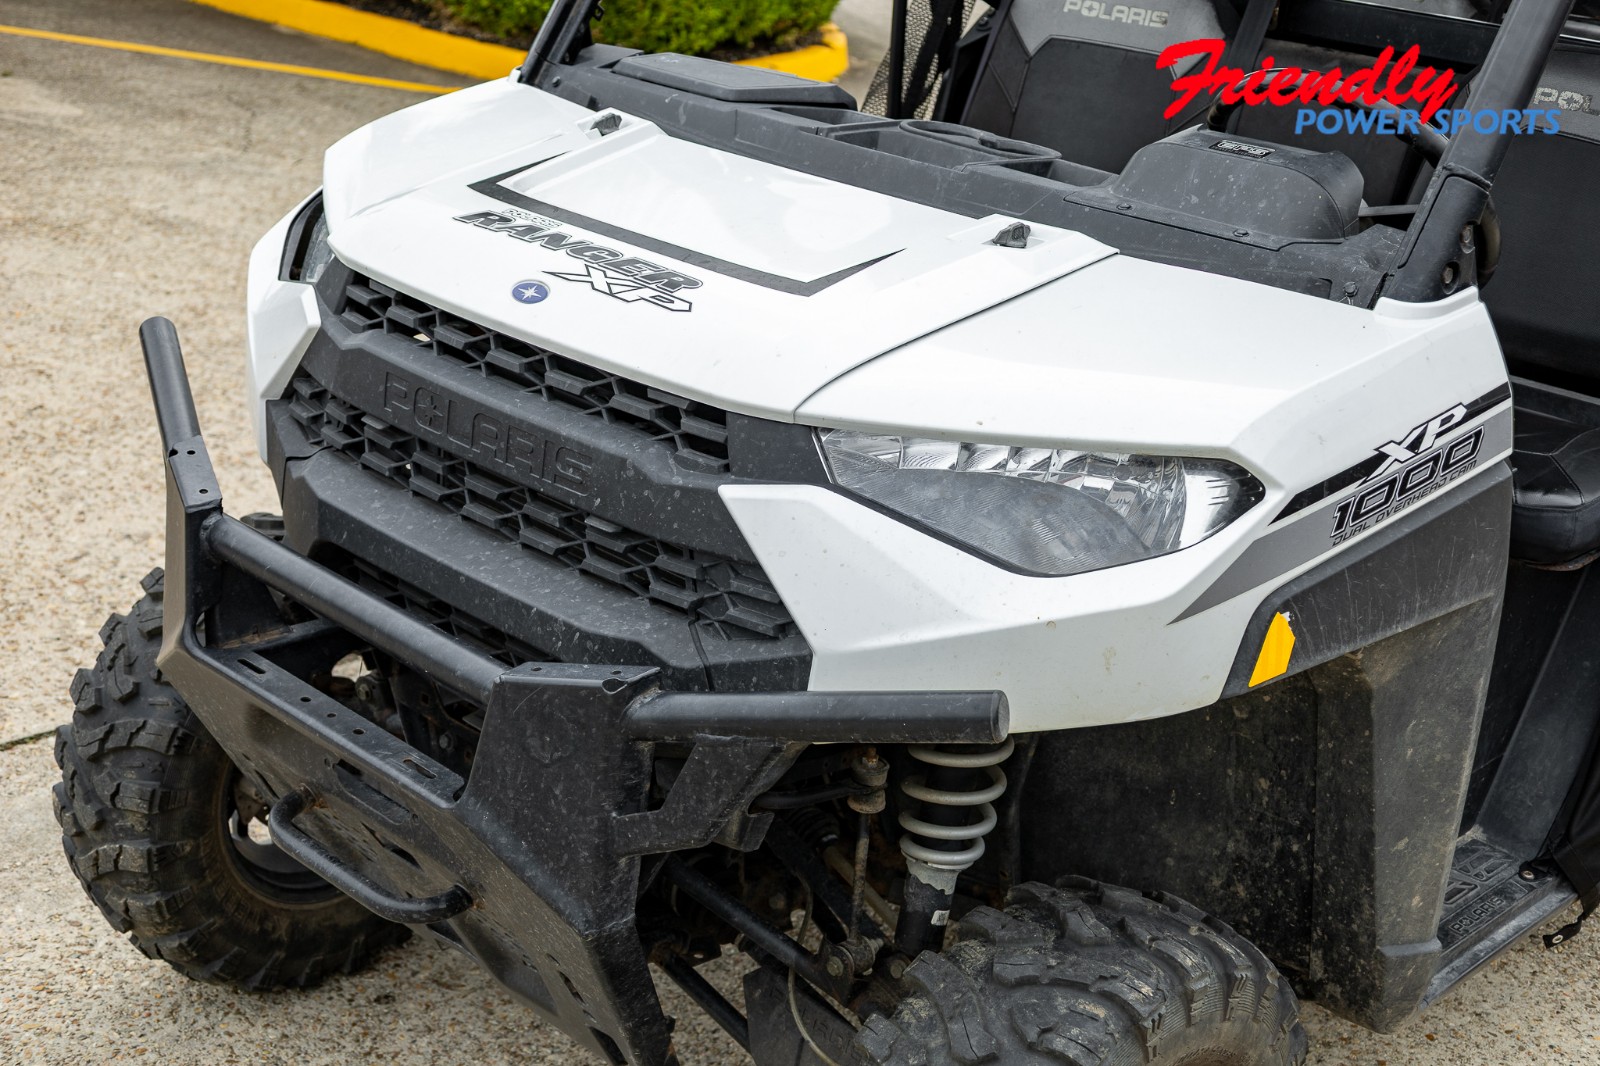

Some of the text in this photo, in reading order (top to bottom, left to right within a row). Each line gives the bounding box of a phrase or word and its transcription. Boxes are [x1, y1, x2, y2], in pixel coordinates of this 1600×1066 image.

[1063, 0, 1168, 28] POLARIS
[453, 209, 703, 292] RANGER
[542, 263, 692, 313] XP
[383, 371, 593, 498] POLARIS
[1357, 402, 1468, 488] XP
[1330, 425, 1485, 538] 1000
[1332, 459, 1477, 546] DUAL OVERHEAD CAM
[1450, 897, 1504, 935] POLARIS
